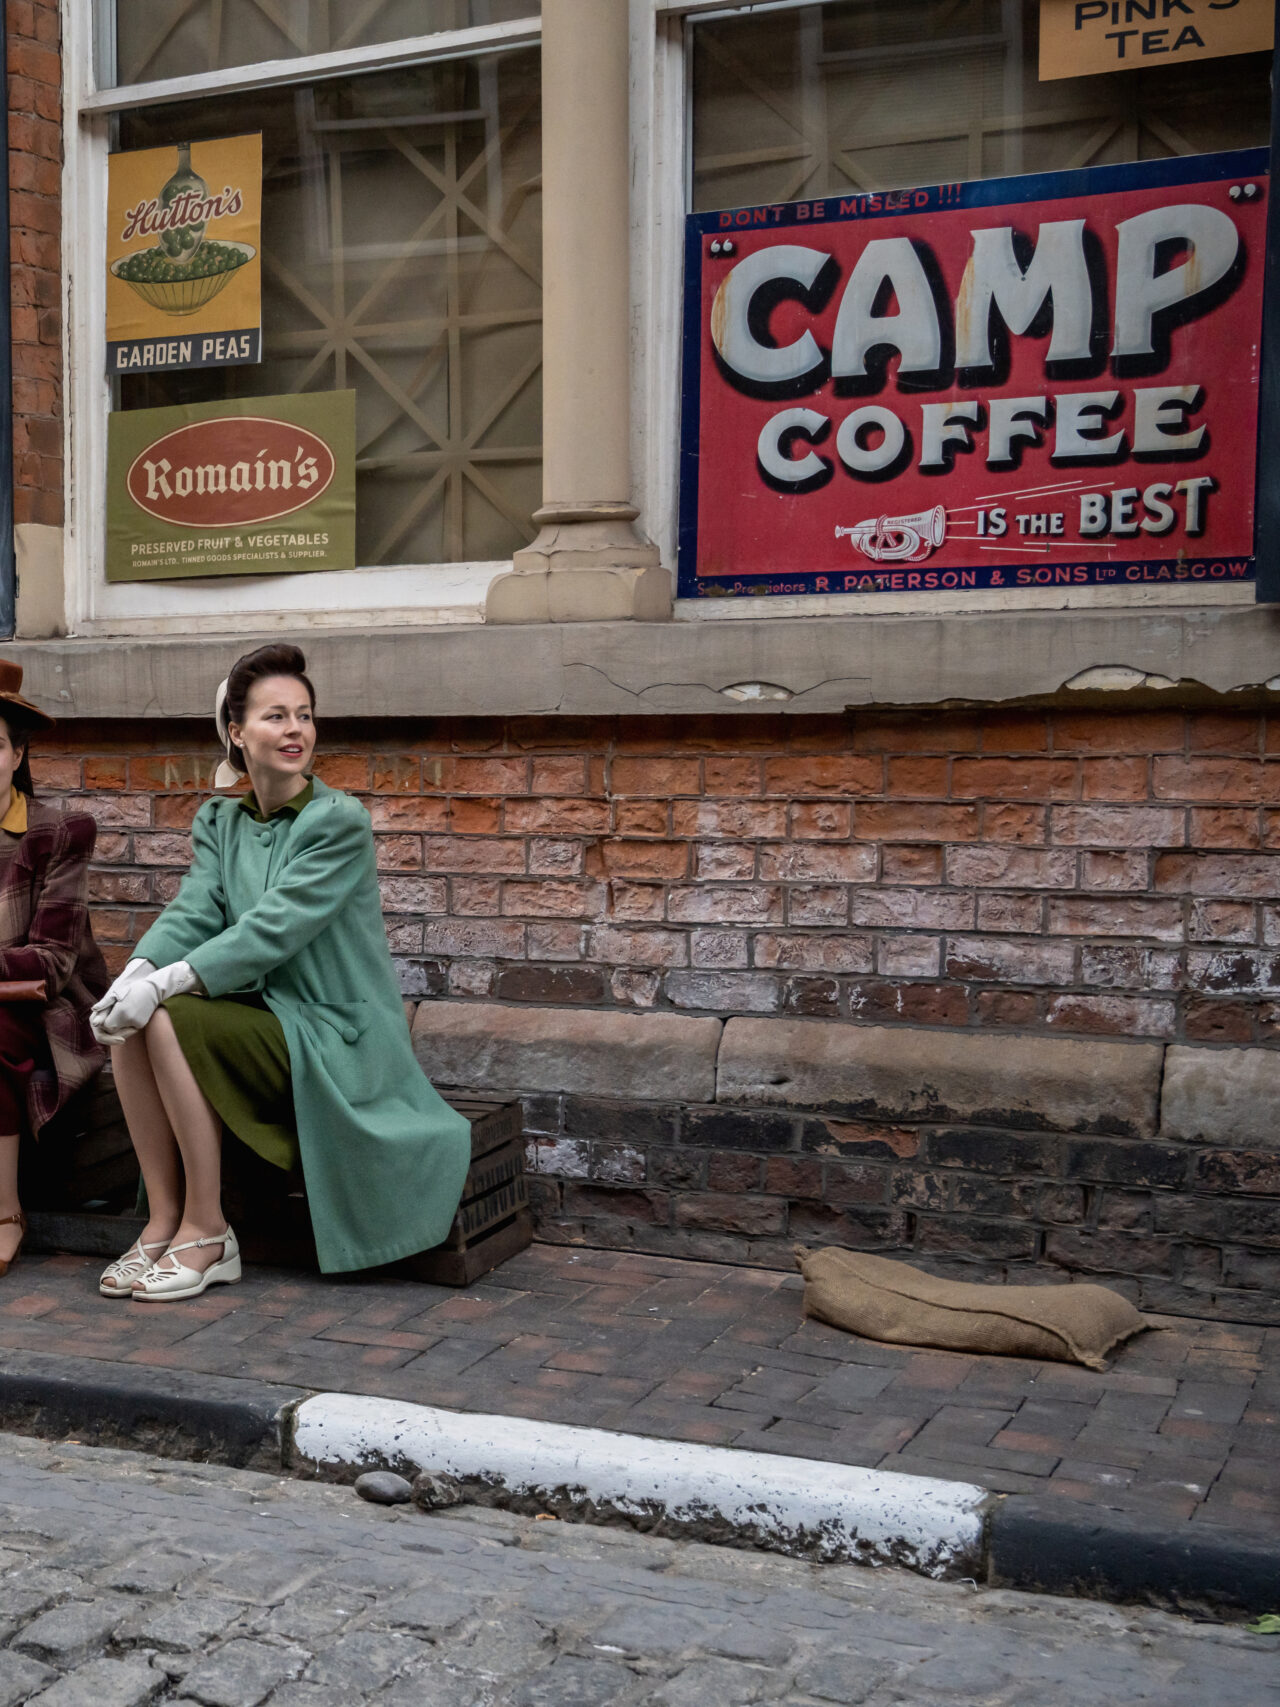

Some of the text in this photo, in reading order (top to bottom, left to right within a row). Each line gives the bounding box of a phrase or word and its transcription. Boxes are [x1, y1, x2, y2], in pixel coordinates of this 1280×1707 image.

[1075, 0, 1240, 31] PINK
[1105, 25, 1206, 59] TEA
[122, 186, 242, 241] Hutton's
[719, 183, 962, 228] DON'T BE MISLED !!!
[117, 335, 250, 368] GARDEN PEAS
[757, 385, 1207, 481] COFFEE
[143, 445, 319, 501] Romain's
[976, 476, 1213, 536] IS THE BEST
[131, 533, 329, 556] PRESERVED FRUIT & VEGETABLES
[182, 555, 206, 564] TINNED
[206, 554, 231, 562] GOODS
[233, 551, 279, 561] SPECIALISTS
[845, 571, 975, 591] PATERSON
[989, 571, 1005, 586] &
[1016, 566, 1088, 584] SONS
[1126, 562, 1248, 581] GLASGOW
